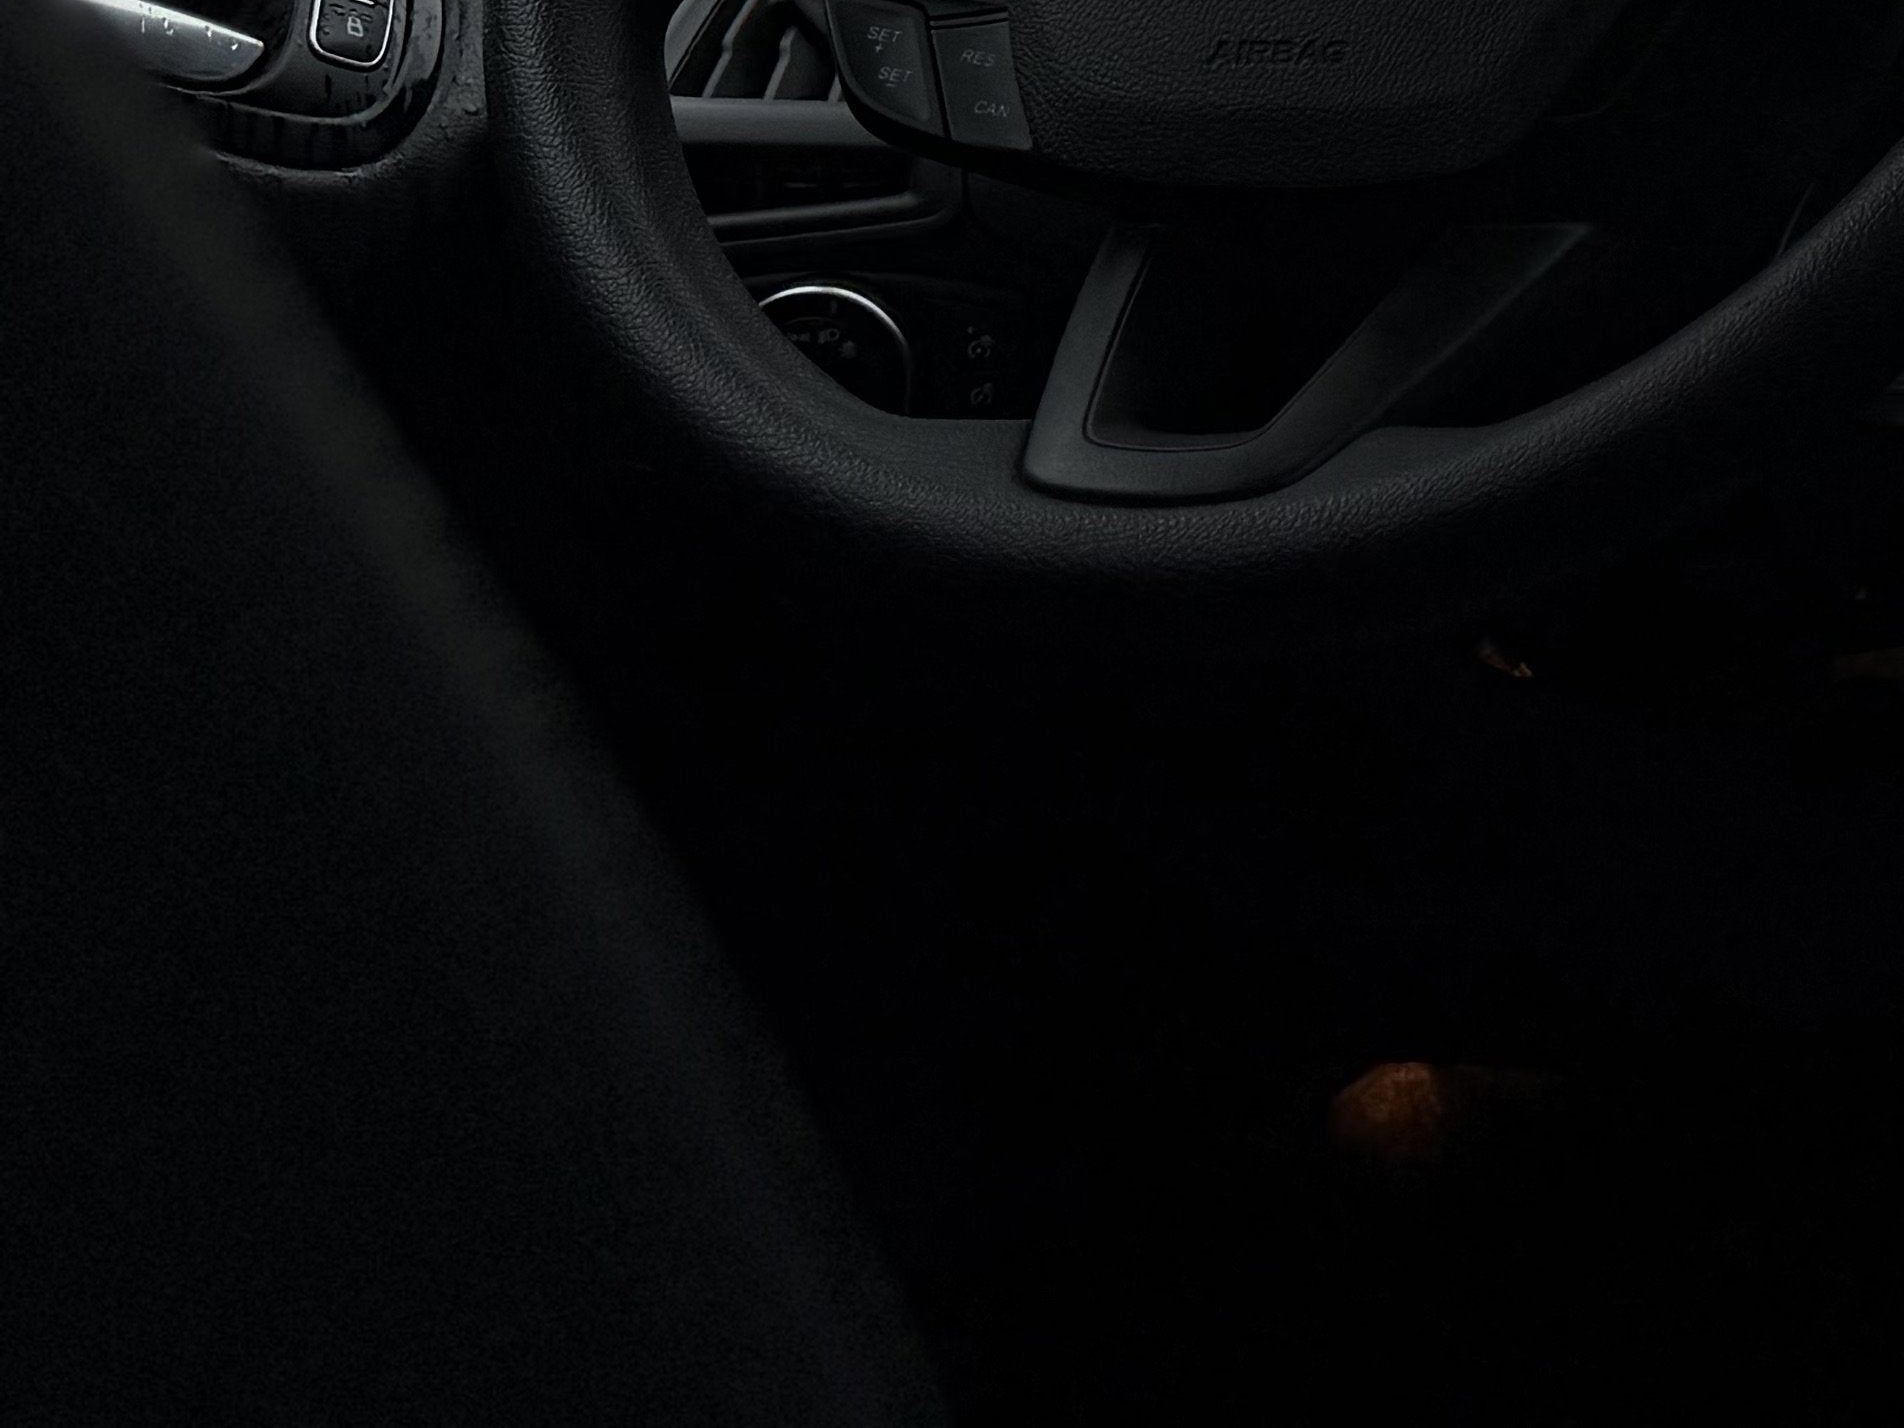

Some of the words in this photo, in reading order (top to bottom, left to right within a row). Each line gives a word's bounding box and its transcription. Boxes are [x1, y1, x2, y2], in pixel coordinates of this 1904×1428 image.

[867, 26, 903, 42] SET
[960, 49, 996, 67] RES
[878, 66, 913, 82] SET
[974, 100, 1010, 118] CAN
